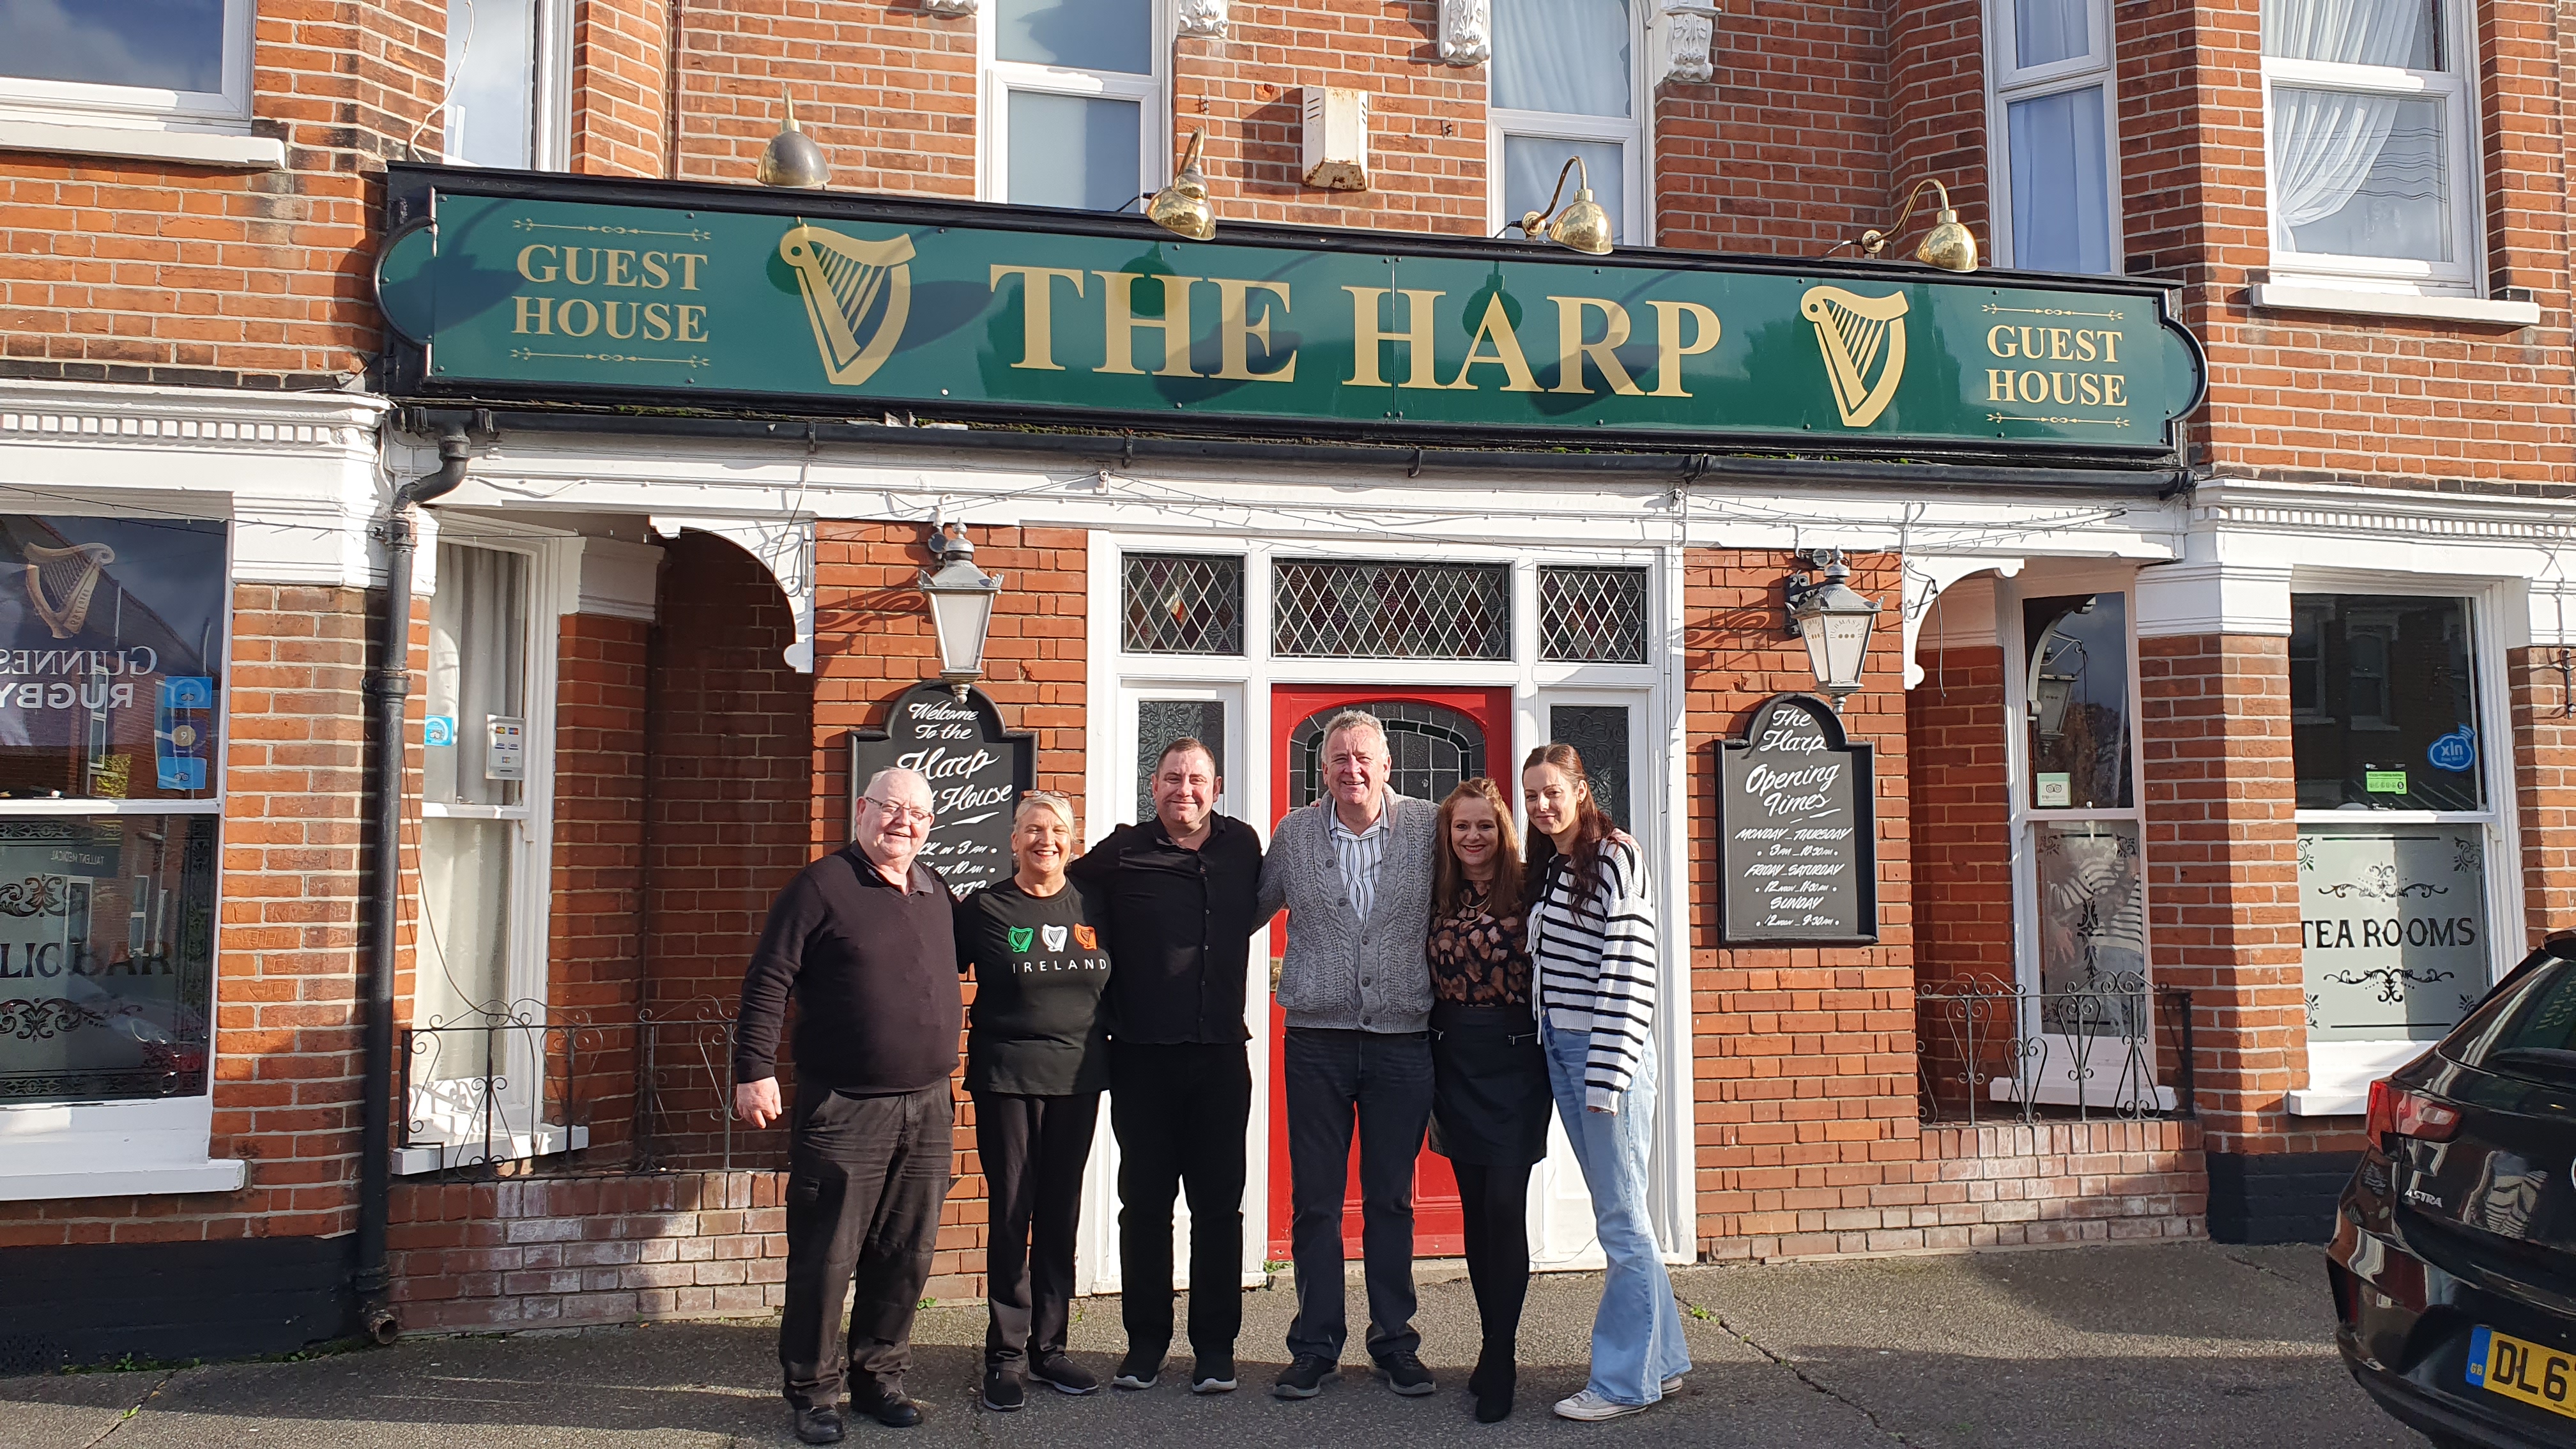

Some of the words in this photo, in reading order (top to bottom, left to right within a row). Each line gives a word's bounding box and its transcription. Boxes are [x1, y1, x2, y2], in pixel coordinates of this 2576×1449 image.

[516, 243, 709, 291] GUEST
[511, 296, 709, 342] HOUSE
[990, 263, 1298, 383] THE
[1341, 285, 1721, 397] HARP
[1986, 324, 2124, 363] GUEST
[1985, 369, 2128, 407] HOUSE
[908, 700, 979, 721] Welcome
[1772, 709, 1812, 727] The
[915, 723, 940, 740] To
[940, 723, 973, 740] the
[1759, 728, 1831, 756] Harp
[896, 746, 1000, 780] Harp
[1745, 763, 1840, 797] Opening
[937, 784, 1013, 815] House
[1763, 792, 1832, 817] Times
[1735, 828, 1789, 841] MONDAY
[1793, 827, 1853, 841] THURSDAY
[1744, 864, 1785, 878] FRIDAY
[1788, 864, 1845, 877] SATURDAY
[1770, 896, 1824, 910] SUNDAY
[2301, 918, 2355, 949] TEA
[2363, 917, 2476, 947] ROOMS
[1013, 959, 1107, 974] IRELAND
[2404, 1190, 2442, 1208] ASTRA
[2492, 1340, 2576, 1402] DL6
